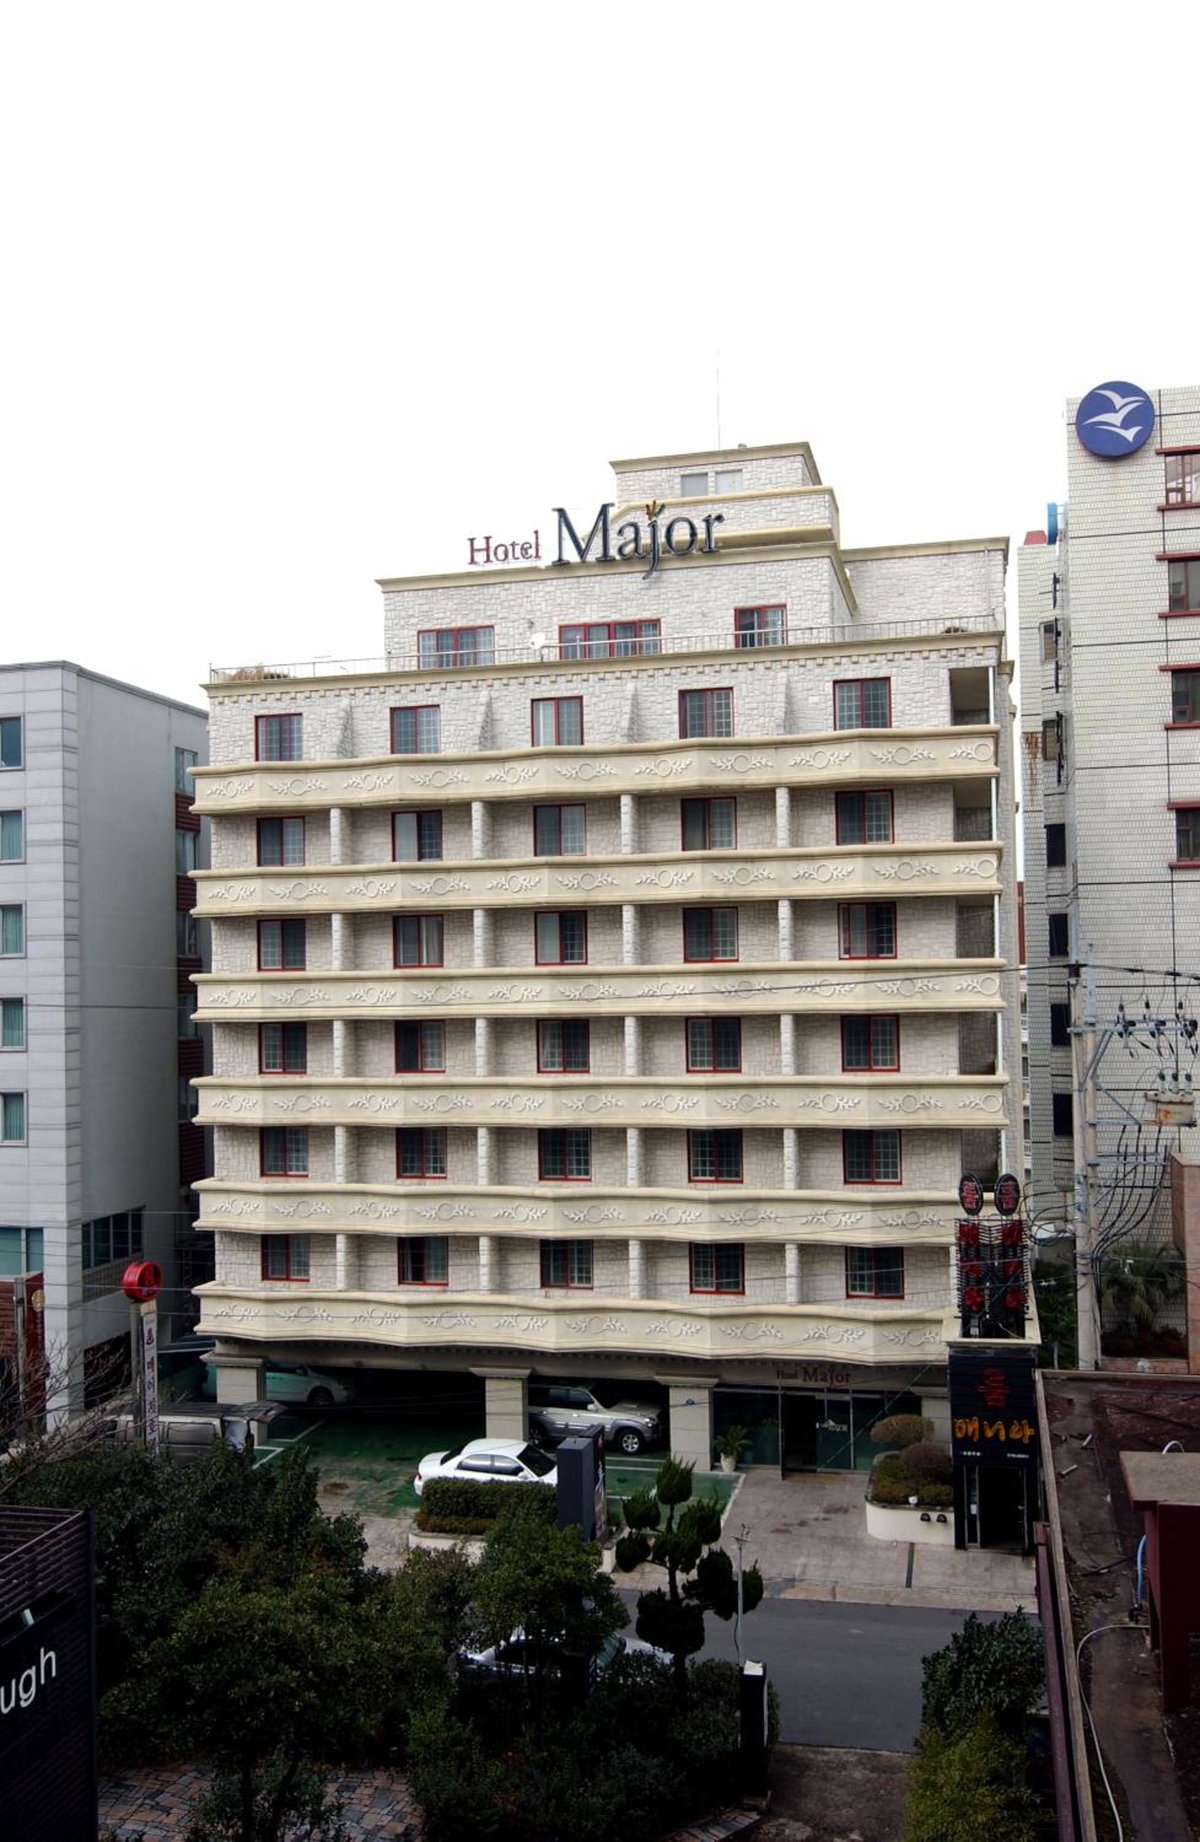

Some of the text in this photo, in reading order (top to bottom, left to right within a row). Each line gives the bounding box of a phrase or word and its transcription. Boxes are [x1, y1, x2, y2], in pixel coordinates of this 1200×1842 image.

[467, 500, 725, 580] Hotel Major
[802, 1367, 851, 1384] Major
[0, 1647, 56, 1714] ugh
